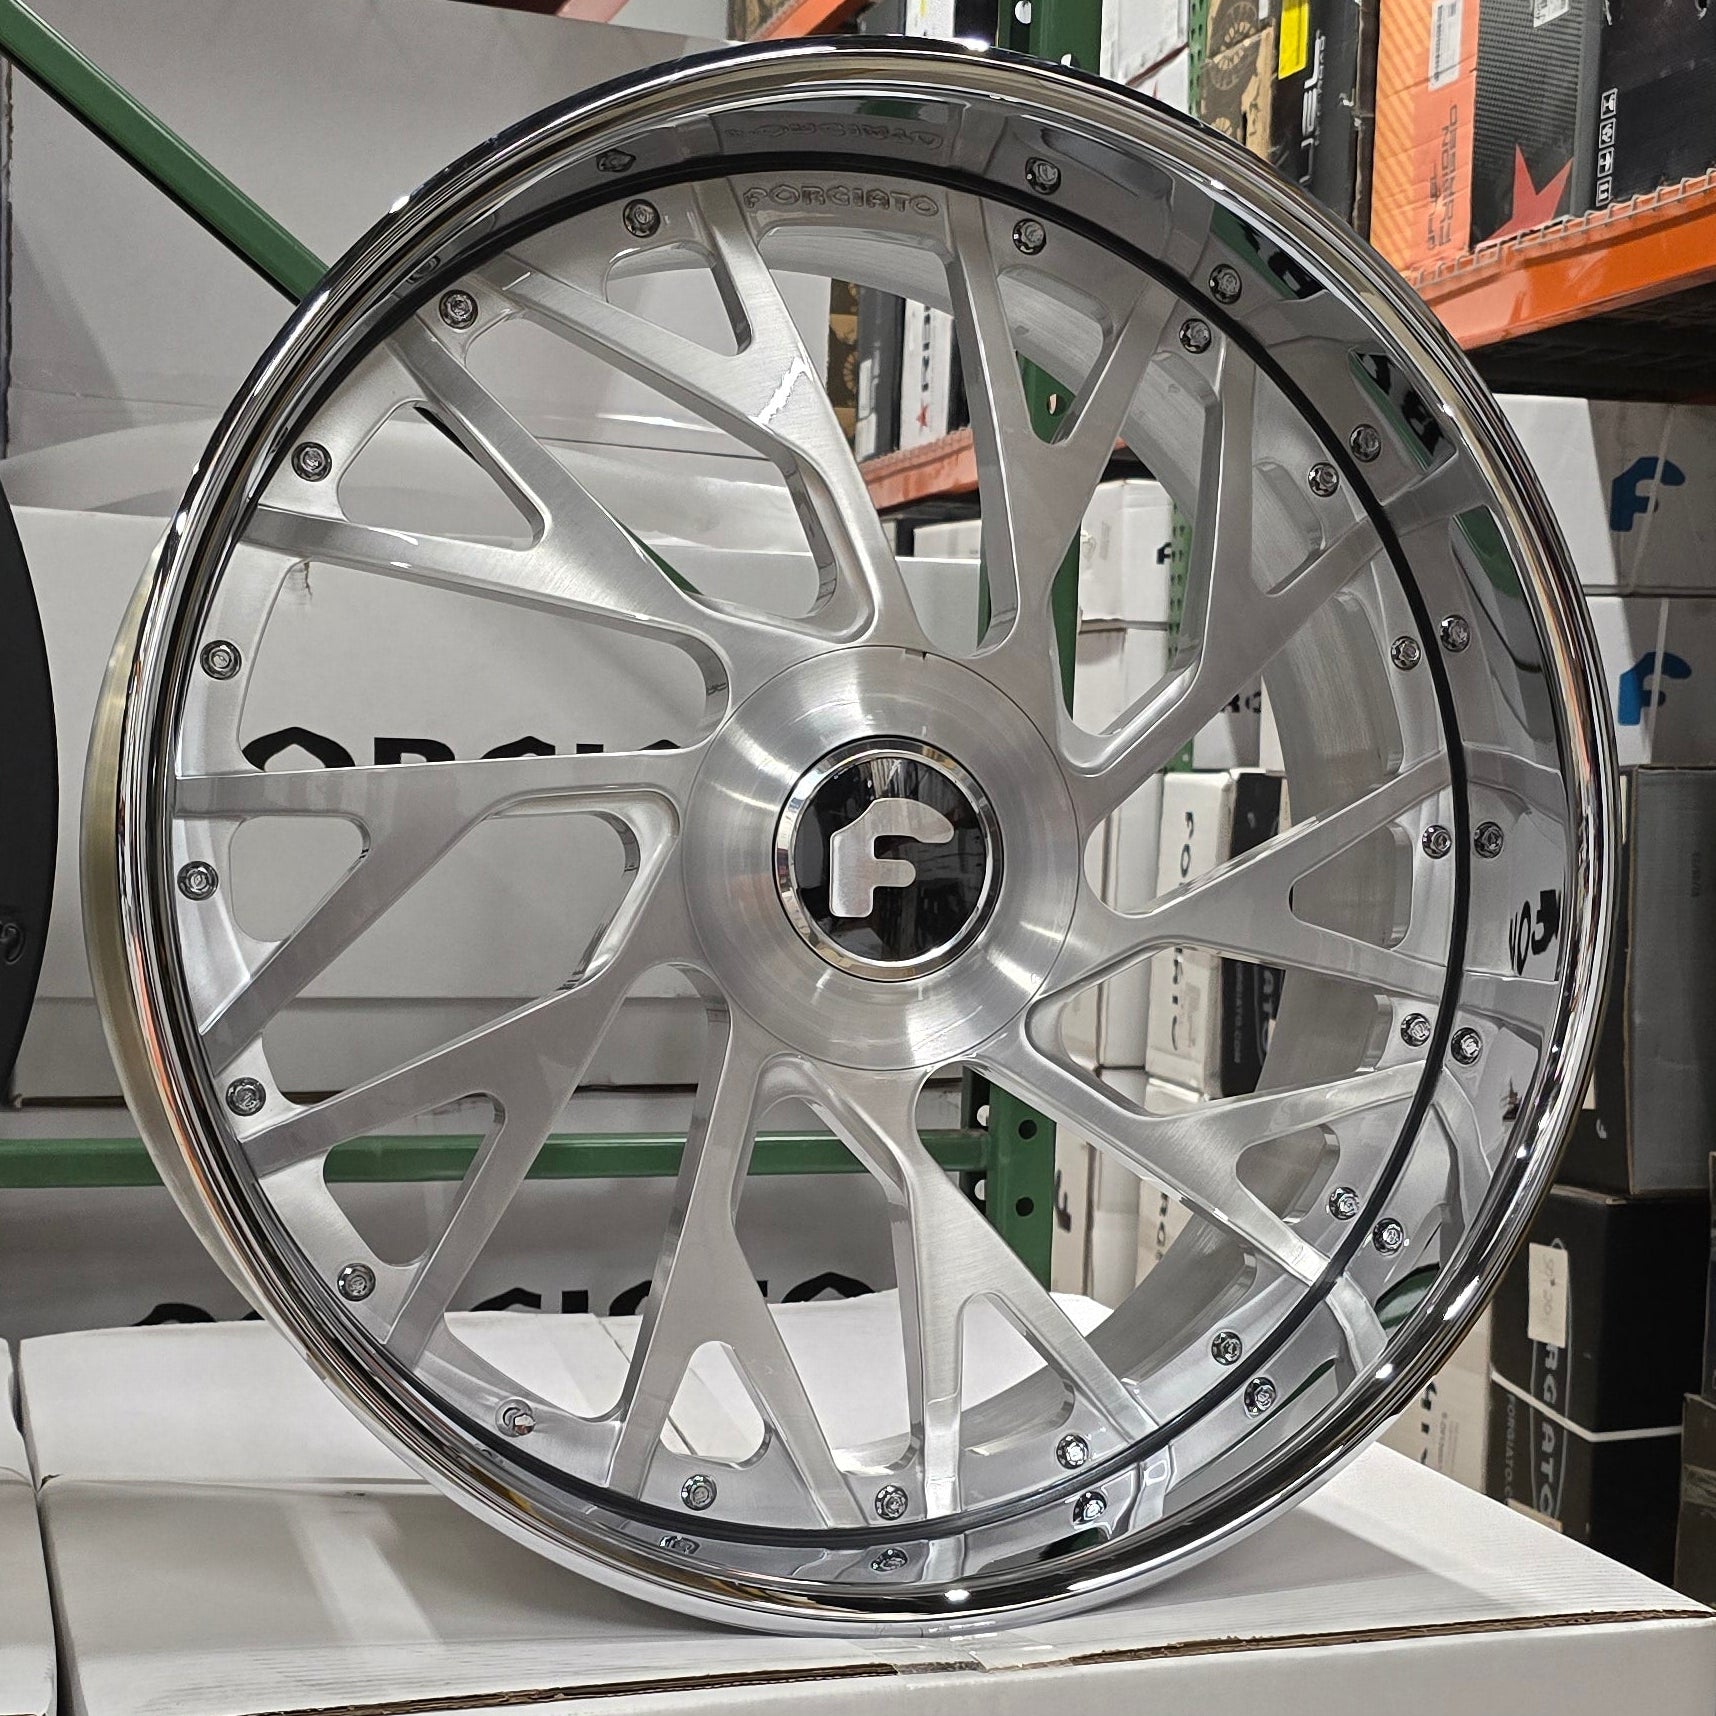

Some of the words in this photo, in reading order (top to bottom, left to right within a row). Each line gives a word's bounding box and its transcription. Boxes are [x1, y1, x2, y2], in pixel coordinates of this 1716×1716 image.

[1299, 38, 1321, 183] UEL
[743, 183, 939, 217] FORGIATO
[1503, 1393, 1517, 1498] FORGIATO.C
[1539, 1343, 1559, 1515] RGATO
